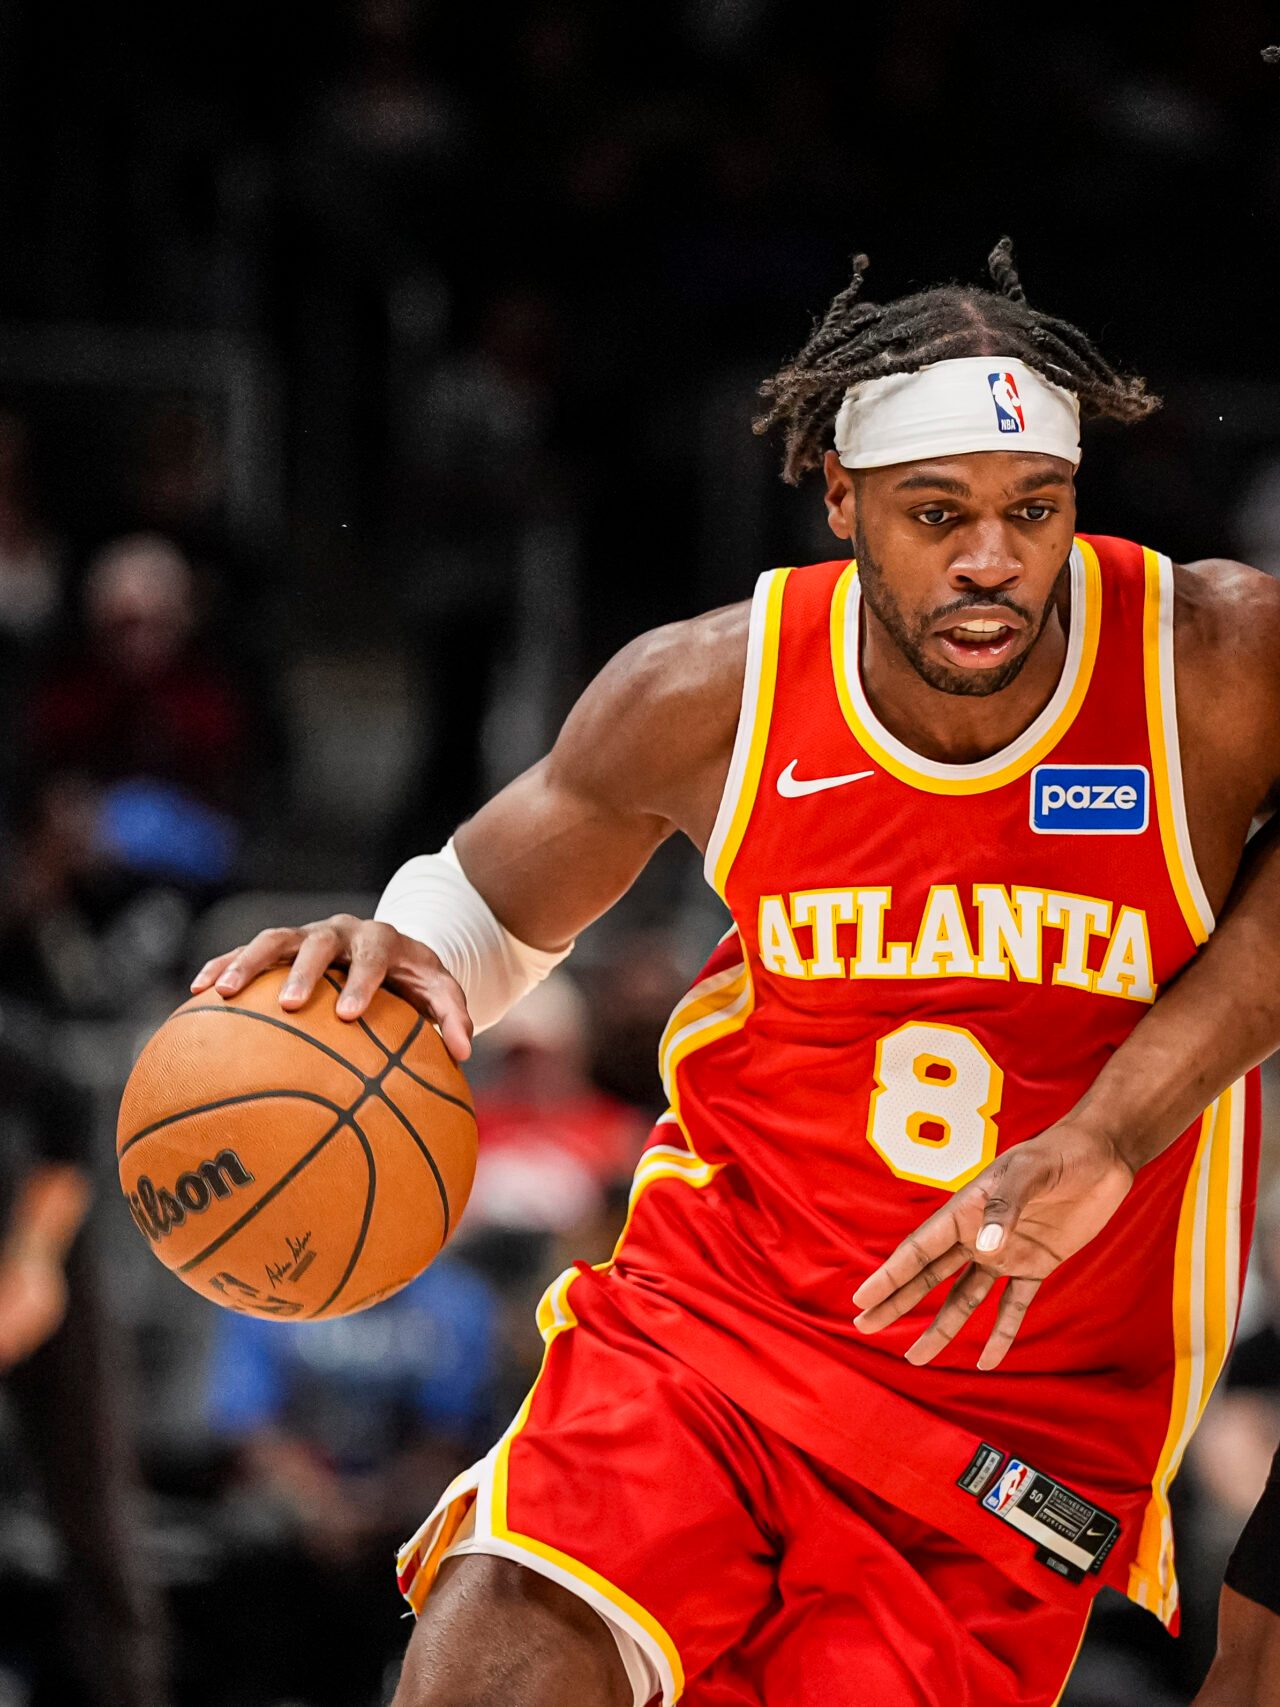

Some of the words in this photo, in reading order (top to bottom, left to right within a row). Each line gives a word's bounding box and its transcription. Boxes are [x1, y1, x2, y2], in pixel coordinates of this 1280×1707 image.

[1000, 418, 1017, 431] NBA
[1041, 785, 1138, 815] paze
[758, 883, 1158, 1004] ATLANTA
[866, 1020, 1004, 1193] 8
[128, 1148, 256, 1243] ilson
[1029, 1489, 1043, 1503] 50
